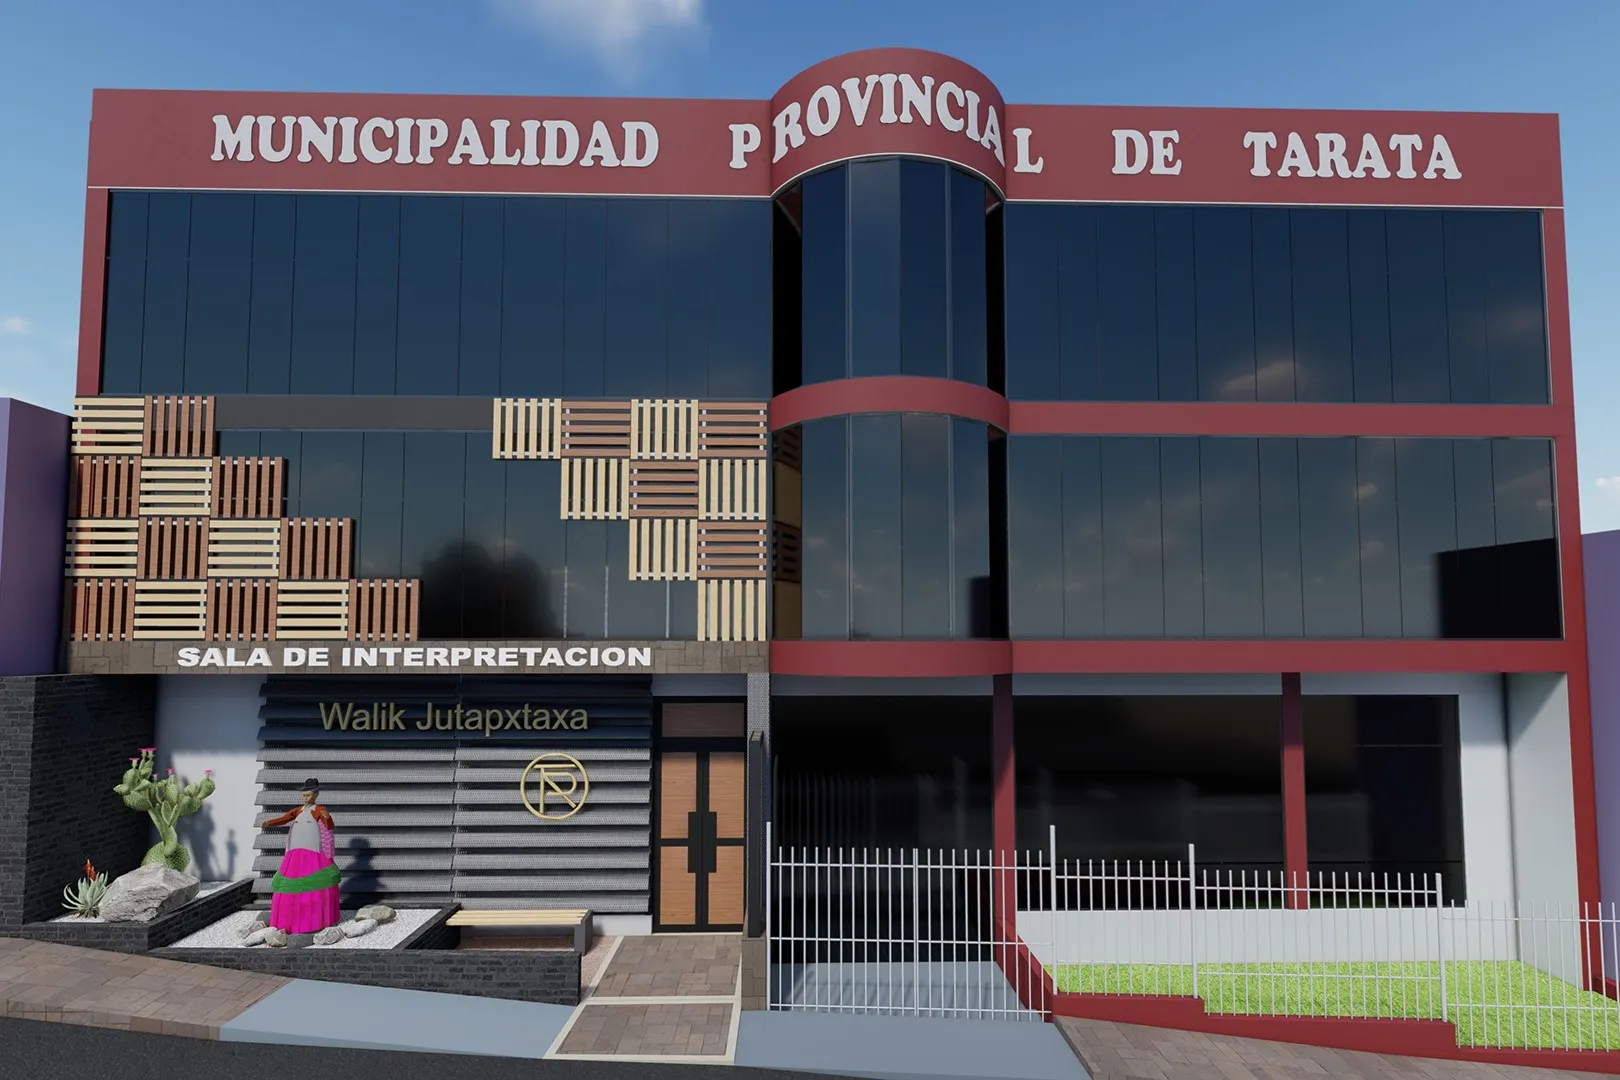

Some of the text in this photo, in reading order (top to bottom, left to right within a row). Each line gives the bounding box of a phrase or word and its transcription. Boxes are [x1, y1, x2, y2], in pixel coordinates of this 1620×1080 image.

[211, 73, 1463, 180] MUNICIPALIDAD PROVINCIAL DE TARATA
[176, 647, 652, 667] SALA DE INTERPRETACION
[318, 702, 589, 737] Walik Jutapxtaxa
